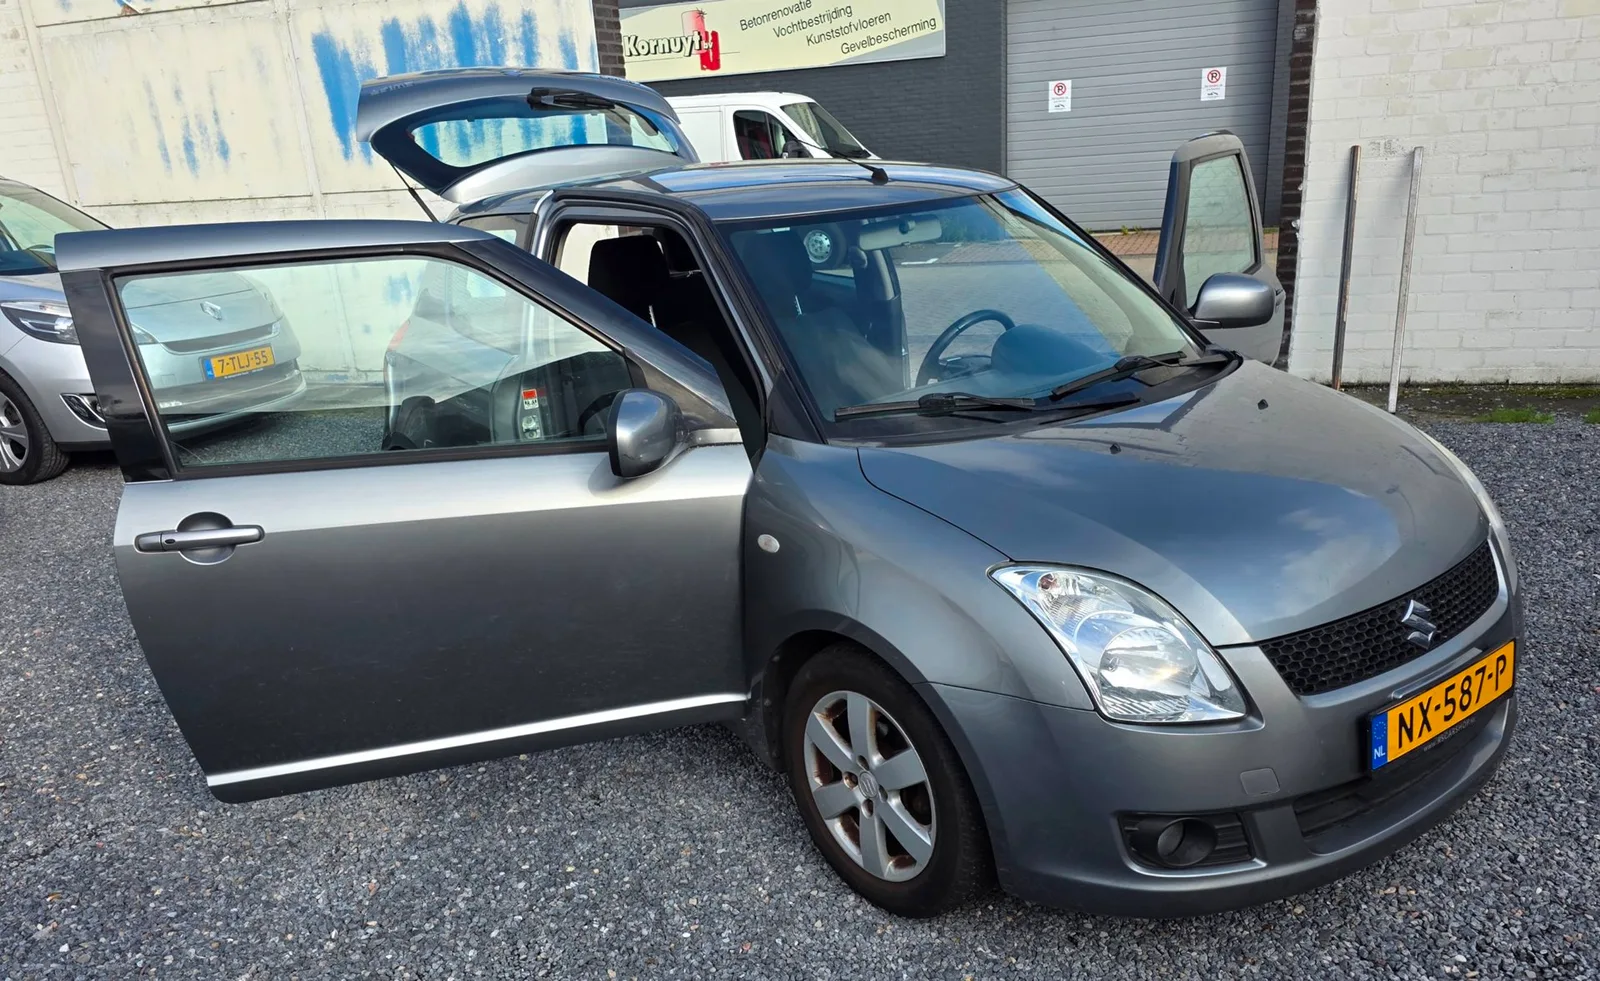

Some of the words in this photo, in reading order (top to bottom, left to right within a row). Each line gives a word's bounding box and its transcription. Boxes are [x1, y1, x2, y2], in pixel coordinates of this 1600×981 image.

[739, 0, 813, 31] Betonrenovatie
[772, 5, 853, 38] Vochtbestrijding
[806, 12, 892, 46] Kunststofvloeren
[622, 30, 702, 57] Kornuyt
[840, 17, 937, 55] Gevelbescherming
[217, 350, 269, 374] 7-TLJ-55
[1398, 654, 1507, 749] NX-587-P
[1373, 745, 1386, 760] NL
